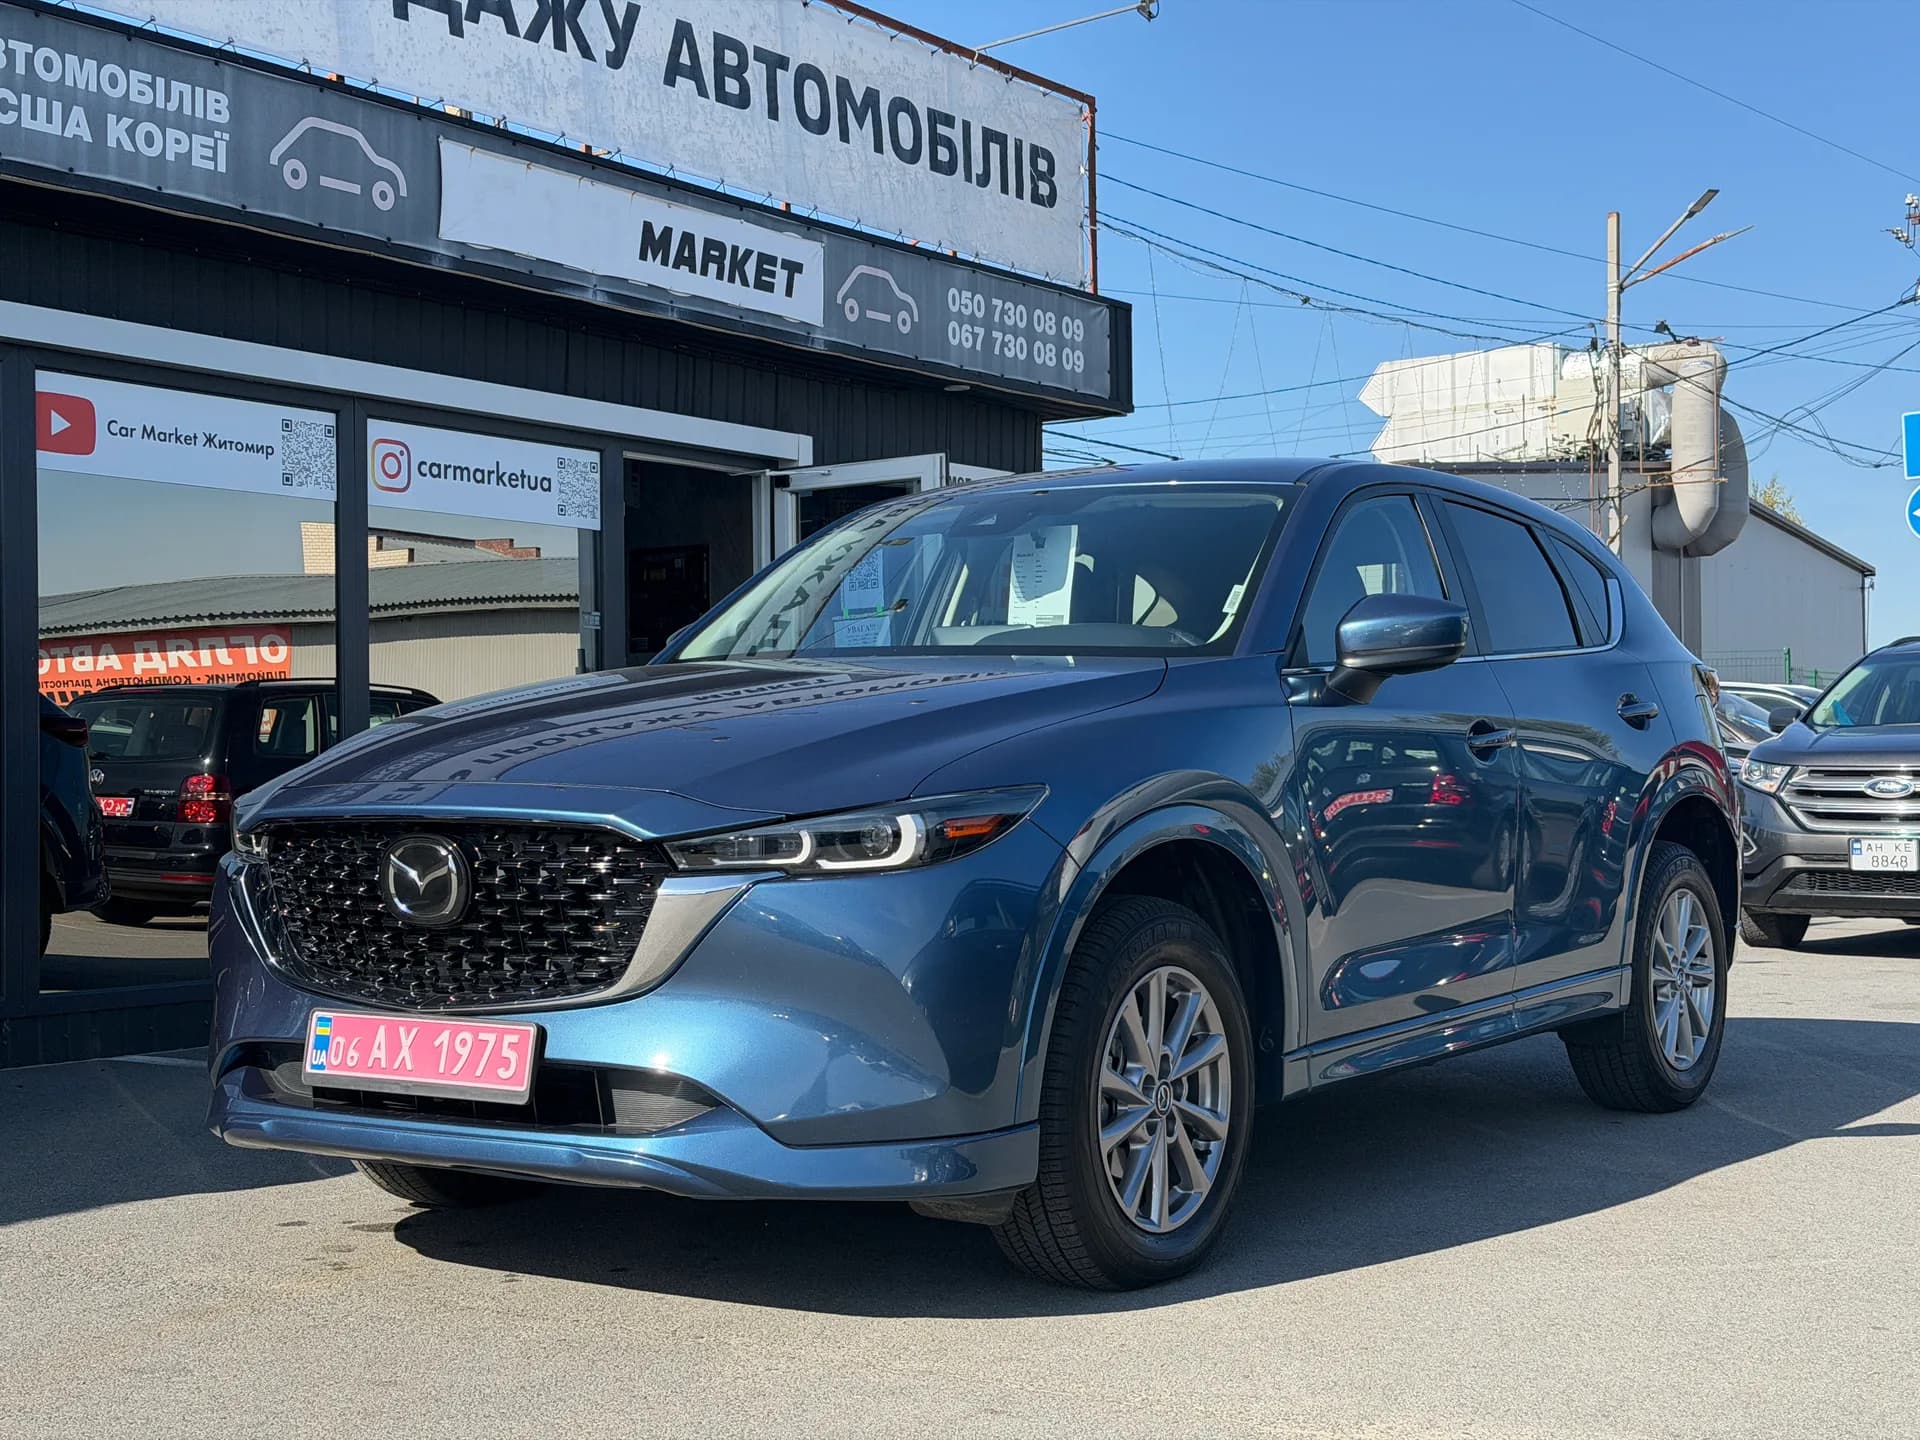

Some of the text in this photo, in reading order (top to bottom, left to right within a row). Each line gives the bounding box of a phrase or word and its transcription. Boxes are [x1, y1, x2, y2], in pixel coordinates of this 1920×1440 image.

[0, 37, 230, 124] ТОМОБІЛІВ
[392, 0, 1058, 209] ЖУ АВТОМОБІЛІВ
[107, 113, 230, 174] КОРЕЇ
[638, 220, 803, 298] MARKET
[947, 287, 1084, 342] 050 730 08 09
[947, 320, 1085, 374] 067 730 08 09
[107, 419, 275, 460] Car Market Житомир
[417, 460, 551, 493] carmarketua
[1866, 843, 1883, 852] AH
[1894, 843, 1912, 852] KE
[1871, 855, 1908, 868] 8848
[312, 1024, 521, 1080] UA 06 AX 1975
